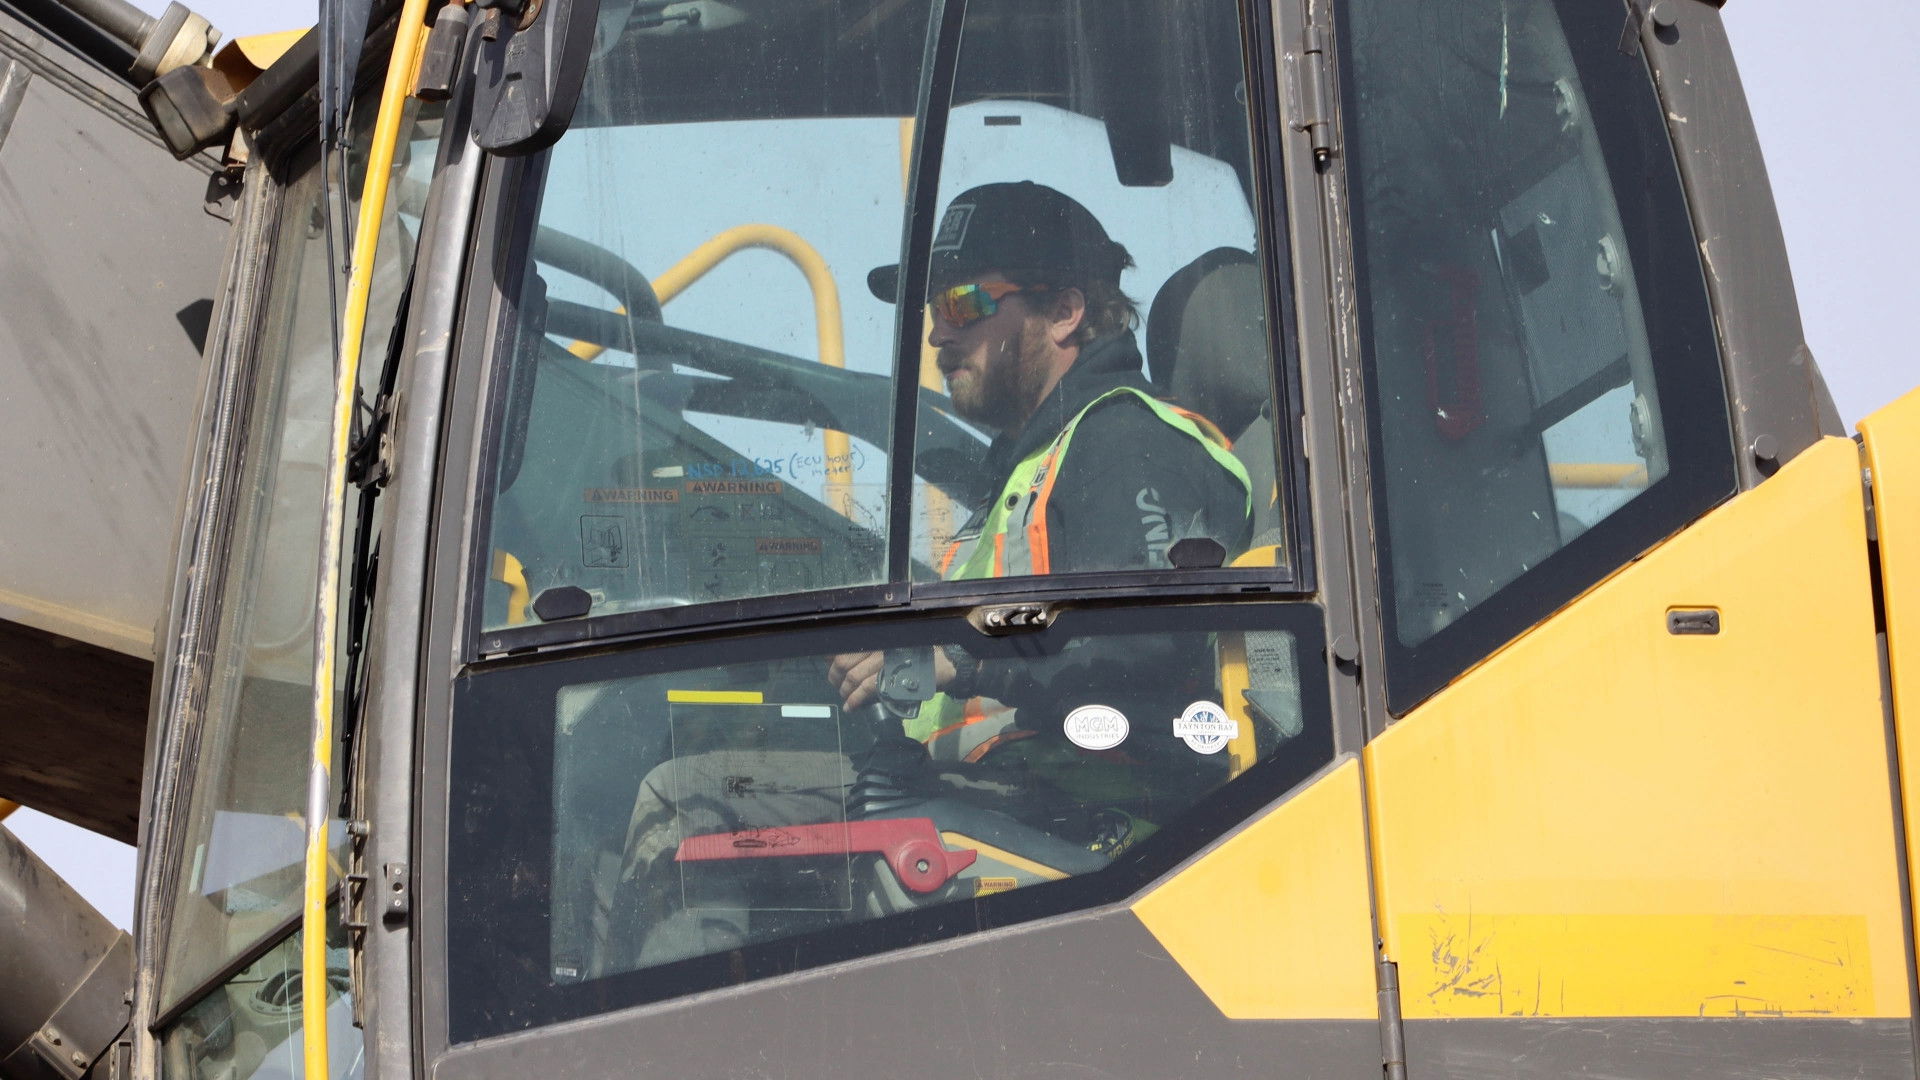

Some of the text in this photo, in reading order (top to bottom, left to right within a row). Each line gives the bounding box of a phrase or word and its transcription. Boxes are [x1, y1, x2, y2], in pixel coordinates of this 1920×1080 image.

[702, 481, 777, 493] WARNING
[602, 488, 675, 501] WARNING
[767, 541, 819, 550] WARNING
[1074, 715, 1119, 732] MGM
